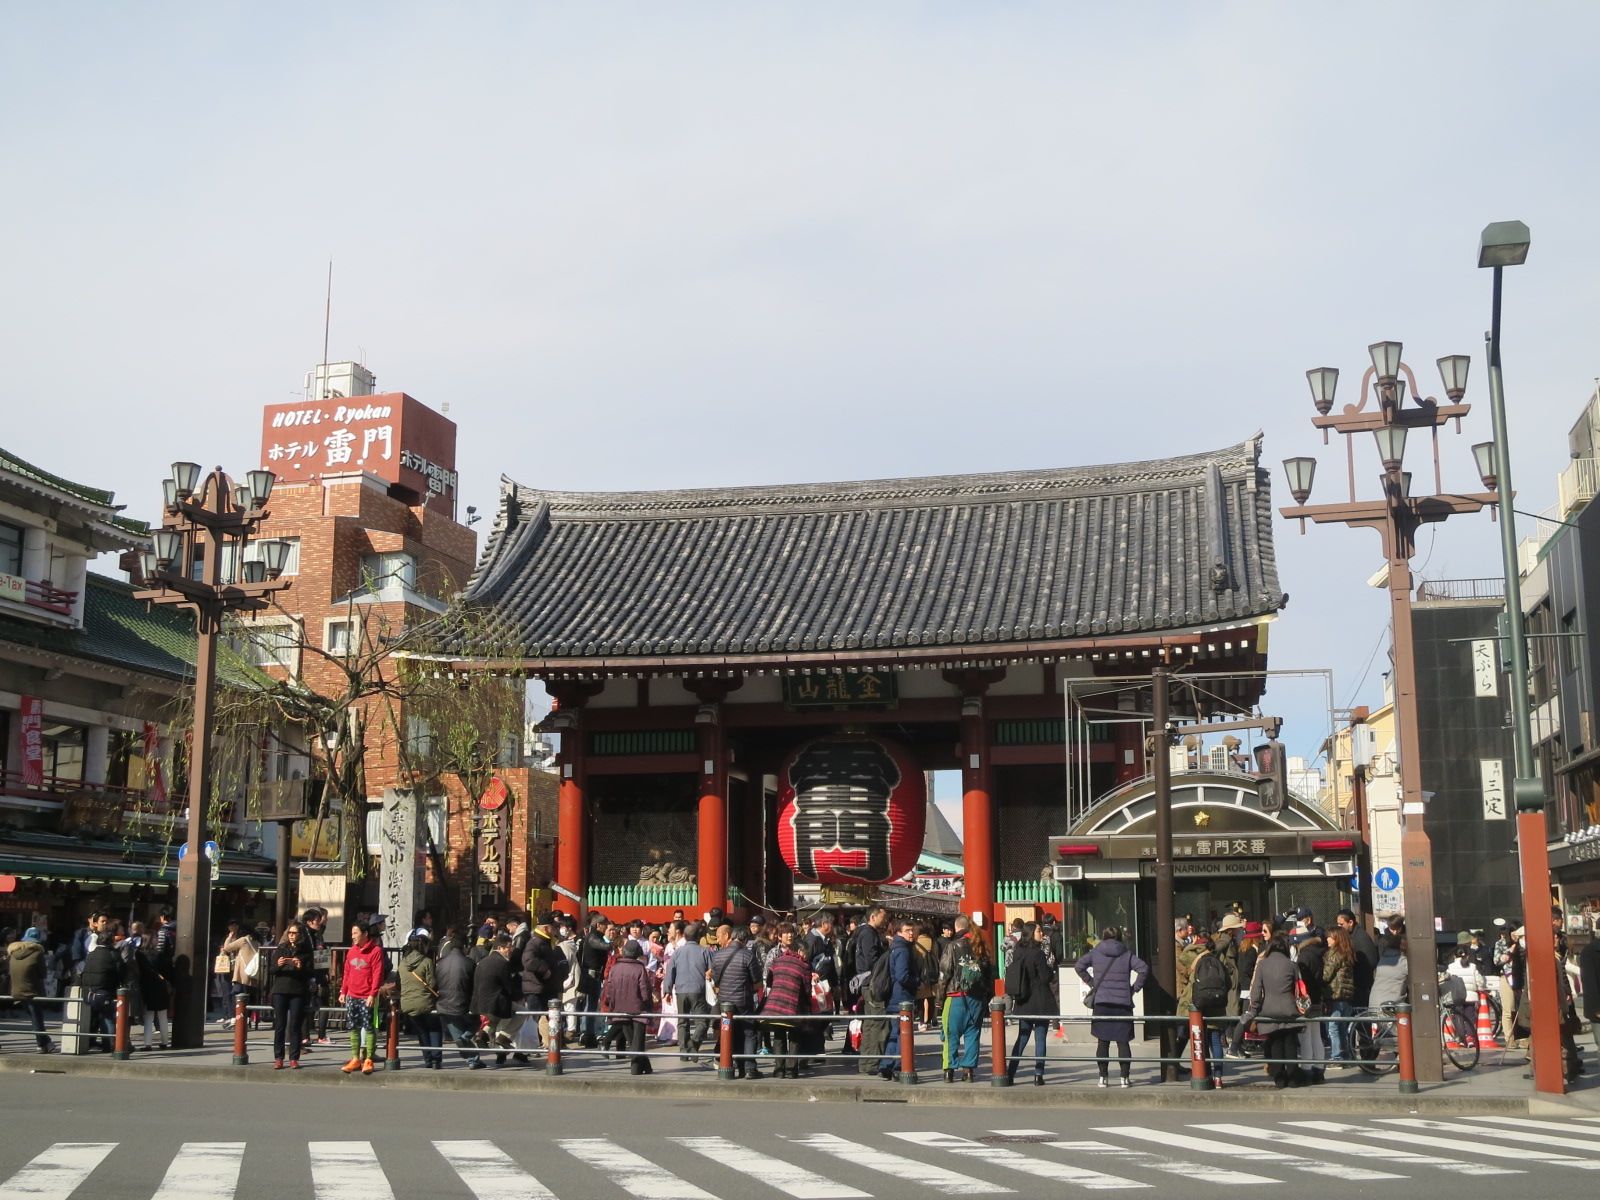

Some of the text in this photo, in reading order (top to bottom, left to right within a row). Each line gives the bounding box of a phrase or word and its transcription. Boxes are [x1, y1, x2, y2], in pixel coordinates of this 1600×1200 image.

[271, 404, 392, 428] HOTEL Ryokan
[1475, 644, 1492, 691] 天ぷら
[788, 740, 902, 883] 雷門
[1484, 779, 1504, 815] 三定
[478, 811, 500, 905] ホテル雷門
[1196, 838, 1267, 855] 雷門交番
[1150, 863, 1259, 874] KNARIMON KOBAN
